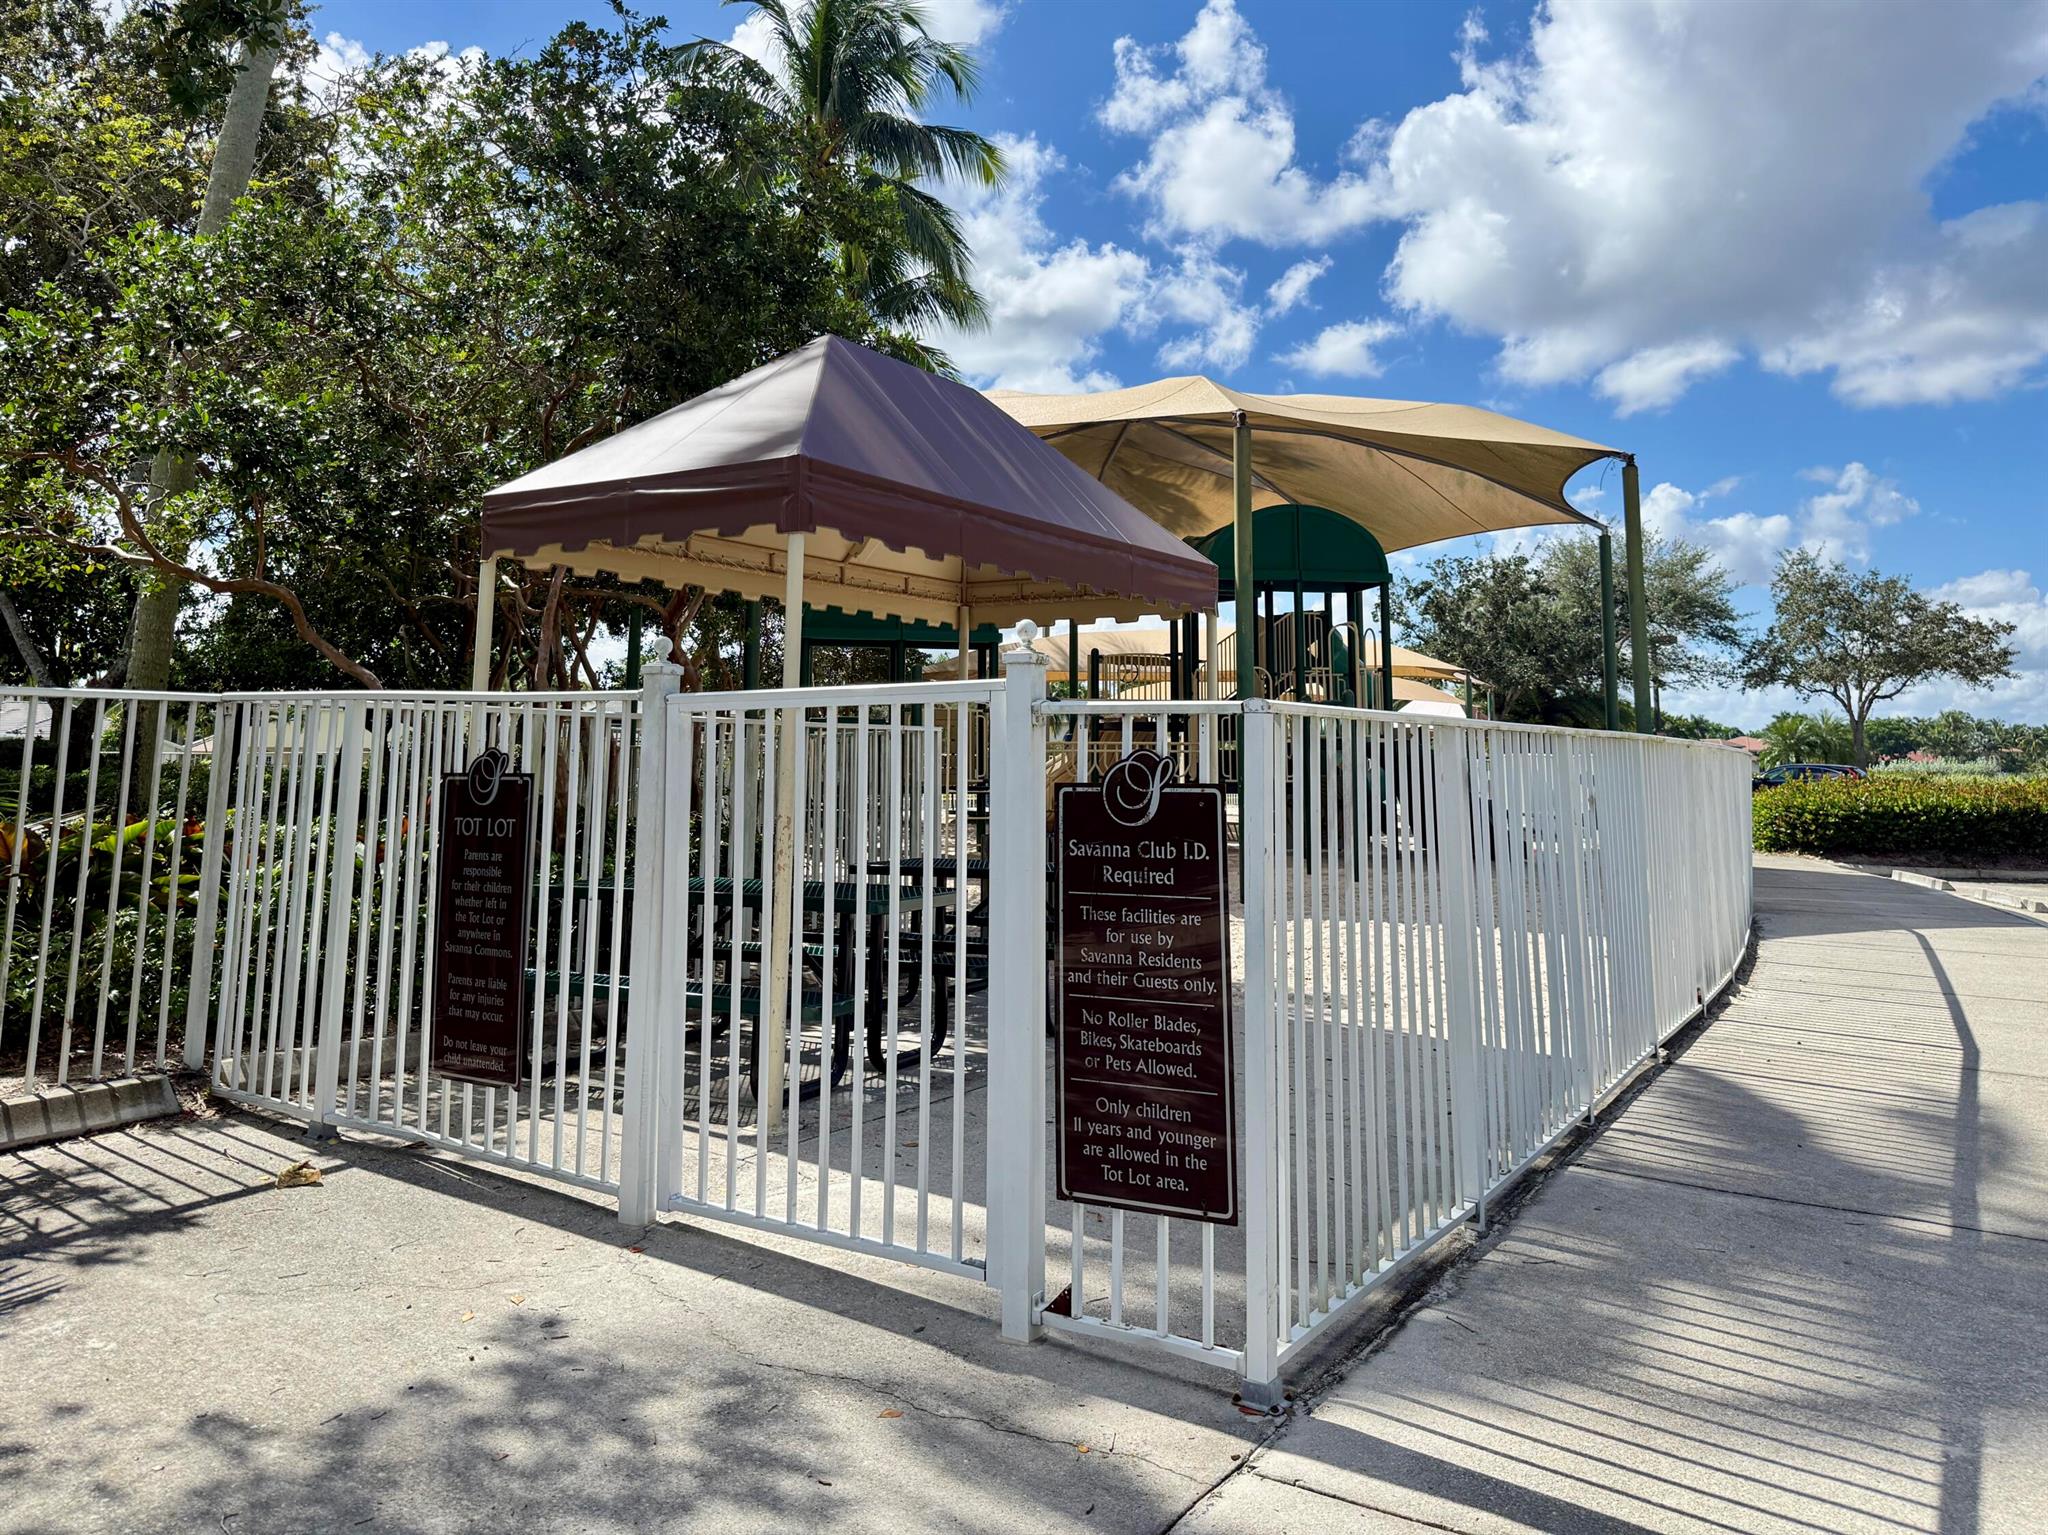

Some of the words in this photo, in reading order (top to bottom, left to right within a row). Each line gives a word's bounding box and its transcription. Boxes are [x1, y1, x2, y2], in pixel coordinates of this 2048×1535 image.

[454, 817, 483, 836] TOT
[487, 819, 516, 838] LOT
[464, 849, 489, 861] Parents
[491, 852, 502, 861] are
[1069, 839, 1130, 858] Savanna
[1138, 841, 1176, 859] Club
[1184, 842, 1210, 860] I.D.
[463, 865, 502, 878] responsible
[1103, 865, 1174, 886] Required
[452, 879, 462, 891] for
[464, 881, 481, 891] their
[483, 882, 512, 894] children
[455, 896, 483, 907] whether
[485, 897, 497, 909] left
[499, 898, 507, 909] in
[456, 911, 467, 922] the
[469, 912, 480, 923] Tot
[482, 913, 494, 924] Lot
[496, 917, 504, 925] or
[1080, 905, 1116, 922] These
[1122, 907, 1175, 924] facilities
[1180, 912, 1201, 925] are
[458, 926, 491, 941] anywhere
[494, 929, 500, 941] in
[1106, 927, 1125, 943] for
[1131, 932, 1151, 945] use
[1157, 931, 1174, 948] by
[445, 941, 472, 955] Savanna
[474, 944, 513, 959] Commons.
[1081, 947, 1132, 966] Savanna
[1138, 951, 1202, 969] Residents
[448, 973, 472, 986] Parents
[475, 978, 485, 988] are
[488, 977, 507, 990] liable
[1068, 968, 1091, 984] and
[1097, 970, 1128, 986] their
[1133, 973, 1179, 990] Guests
[1184, 976, 1217, 995] only.
[450, 988, 460, 1000] for
[462, 993, 475, 1004] any
[478, 992, 504, 1006] injuries
[449, 1005, 462, 1016] that
[465, 1010, 480, 1021] may
[482, 1012, 503, 1022] occur.
[1082, 1009, 1103, 1025] No
[1108, 1011, 1148, 1029] Roller
[1154, 1015, 1201, 1036] Blades,
[444, 1035, 453, 1047] Do
[456, 1040, 467, 1050] not
[470, 1040, 487, 1052] leave
[490, 1045, 507, 1056] your
[1081, 1031, 1116, 1050] Bikes,
[1120, 1034, 1202, 1056] Skateboards
[444, 1052, 460, 1064] child
[463, 1057, 505, 1072] unattended.
[1085, 1056, 1099, 1068] or
[1106, 1055, 1131, 1071] Pets
[1136, 1059, 1197, 1079] Allowed.
[1095, 1097, 1130, 1118] Only
[1136, 1102, 1191, 1122] children
[1087, 1121, 1122, 1137] years
[1126, 1126, 1151, 1140] and
[1158, 1129, 1216, 1150] younger
[1083, 1143, 1103, 1156] are
[1108, 1144, 1159, 1165] allowed
[1166, 1151, 1179, 1167] in
[1185, 1153, 1208, 1171] the
[1101, 1164, 1123, 1182] Tot
[1128, 1168, 1151, 1186] Lot
[1156, 1176, 1189, 1192] area.
